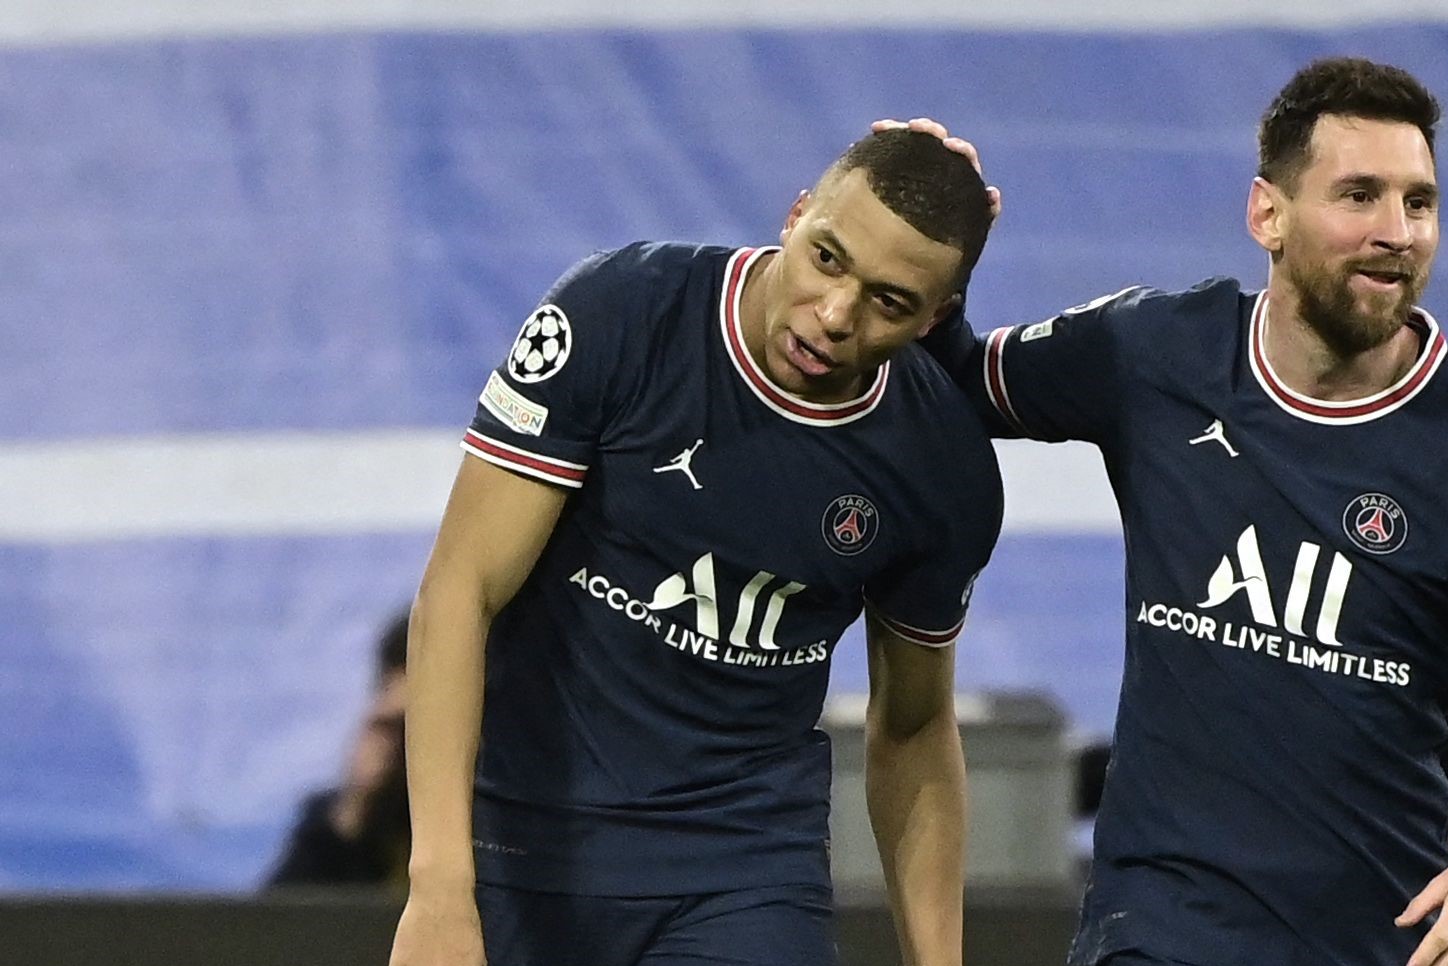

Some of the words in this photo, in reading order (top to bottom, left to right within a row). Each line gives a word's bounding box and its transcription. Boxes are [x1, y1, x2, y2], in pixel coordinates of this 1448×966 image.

[838, 497, 875, 517] PARIS
[1360, 496, 1400, 519] PARIS
[568, 567, 662, 634] ACCOR
[664, 623, 718, 661] LIVE
[1137, 601, 1217, 642] ACCOR
[1222, 622, 1282, 658] LIVE
[1287, 641, 1411, 687] LIMITLESS
